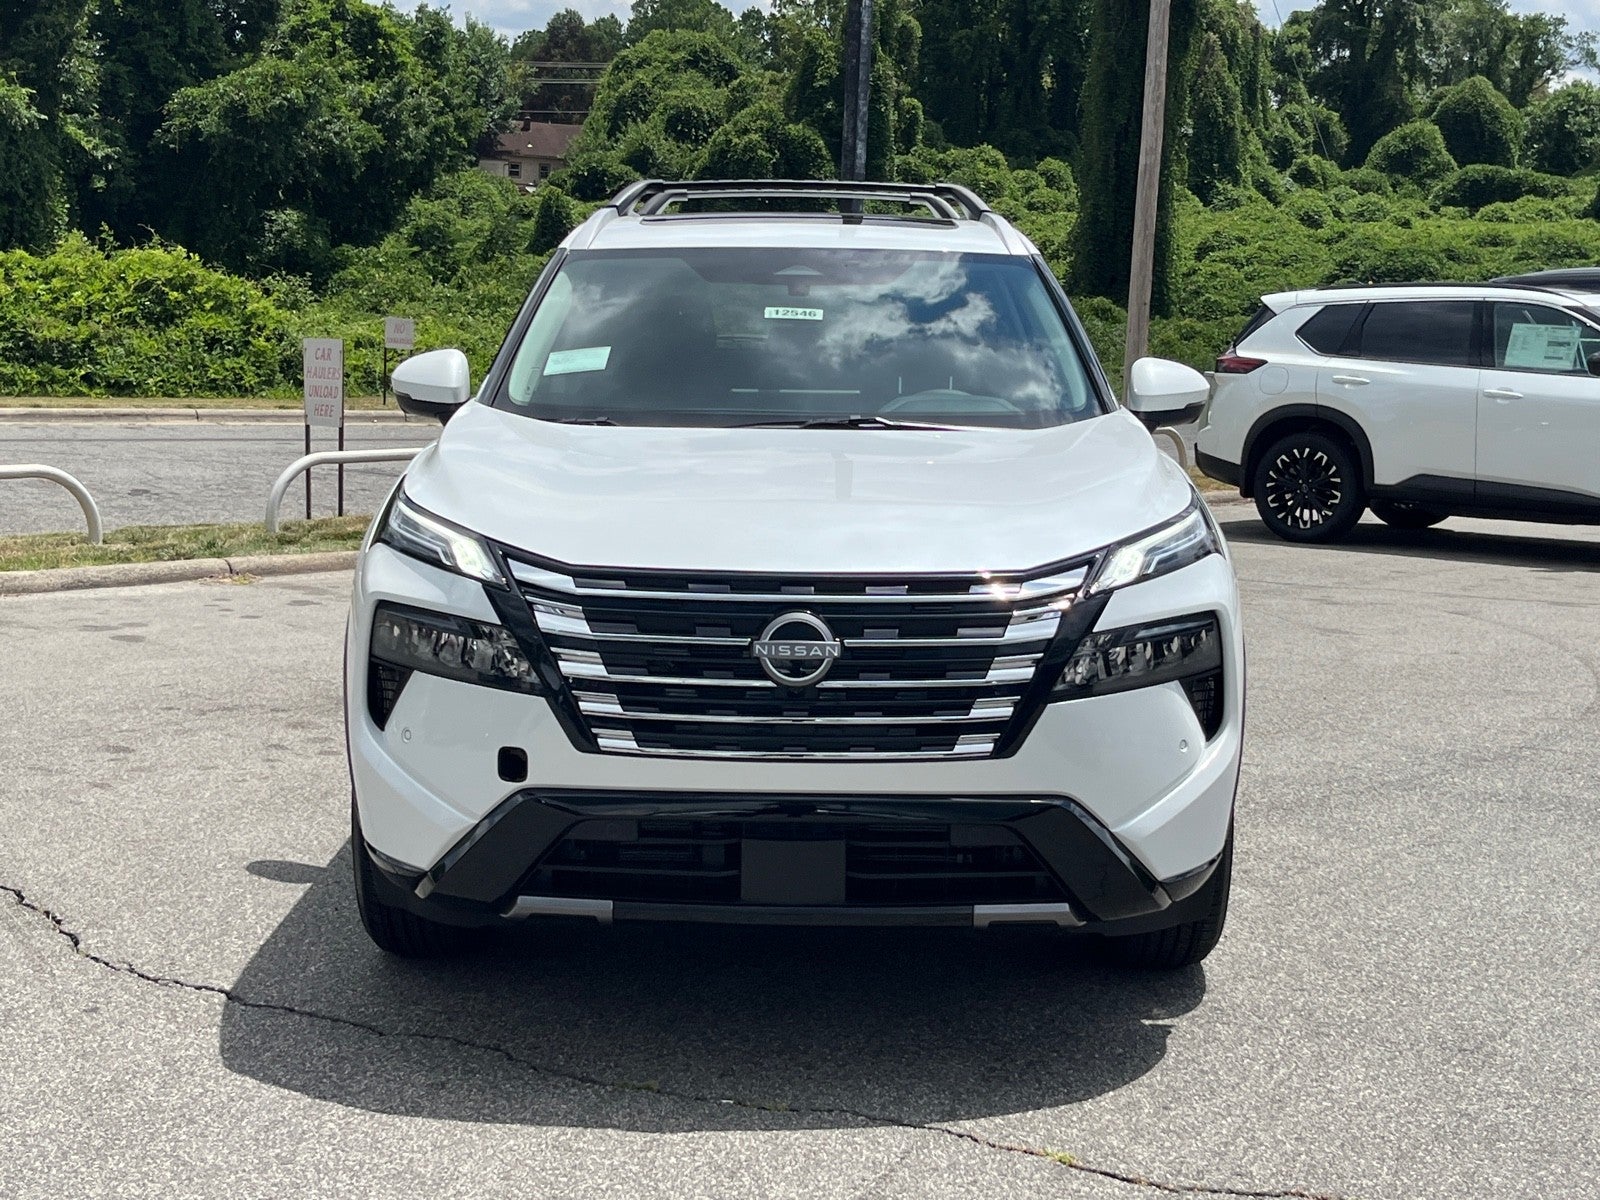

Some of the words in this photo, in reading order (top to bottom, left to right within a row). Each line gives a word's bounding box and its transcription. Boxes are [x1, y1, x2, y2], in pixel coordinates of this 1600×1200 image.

[774, 309, 817, 317] 12546
[393, 323, 406, 334] NO
[315, 347, 332, 360] CAR
[306, 366, 341, 380] HAULERS
[308, 384, 338, 398] UNLOAD
[314, 404, 334, 417] HERE
[755, 644, 839, 657] NISSAN
